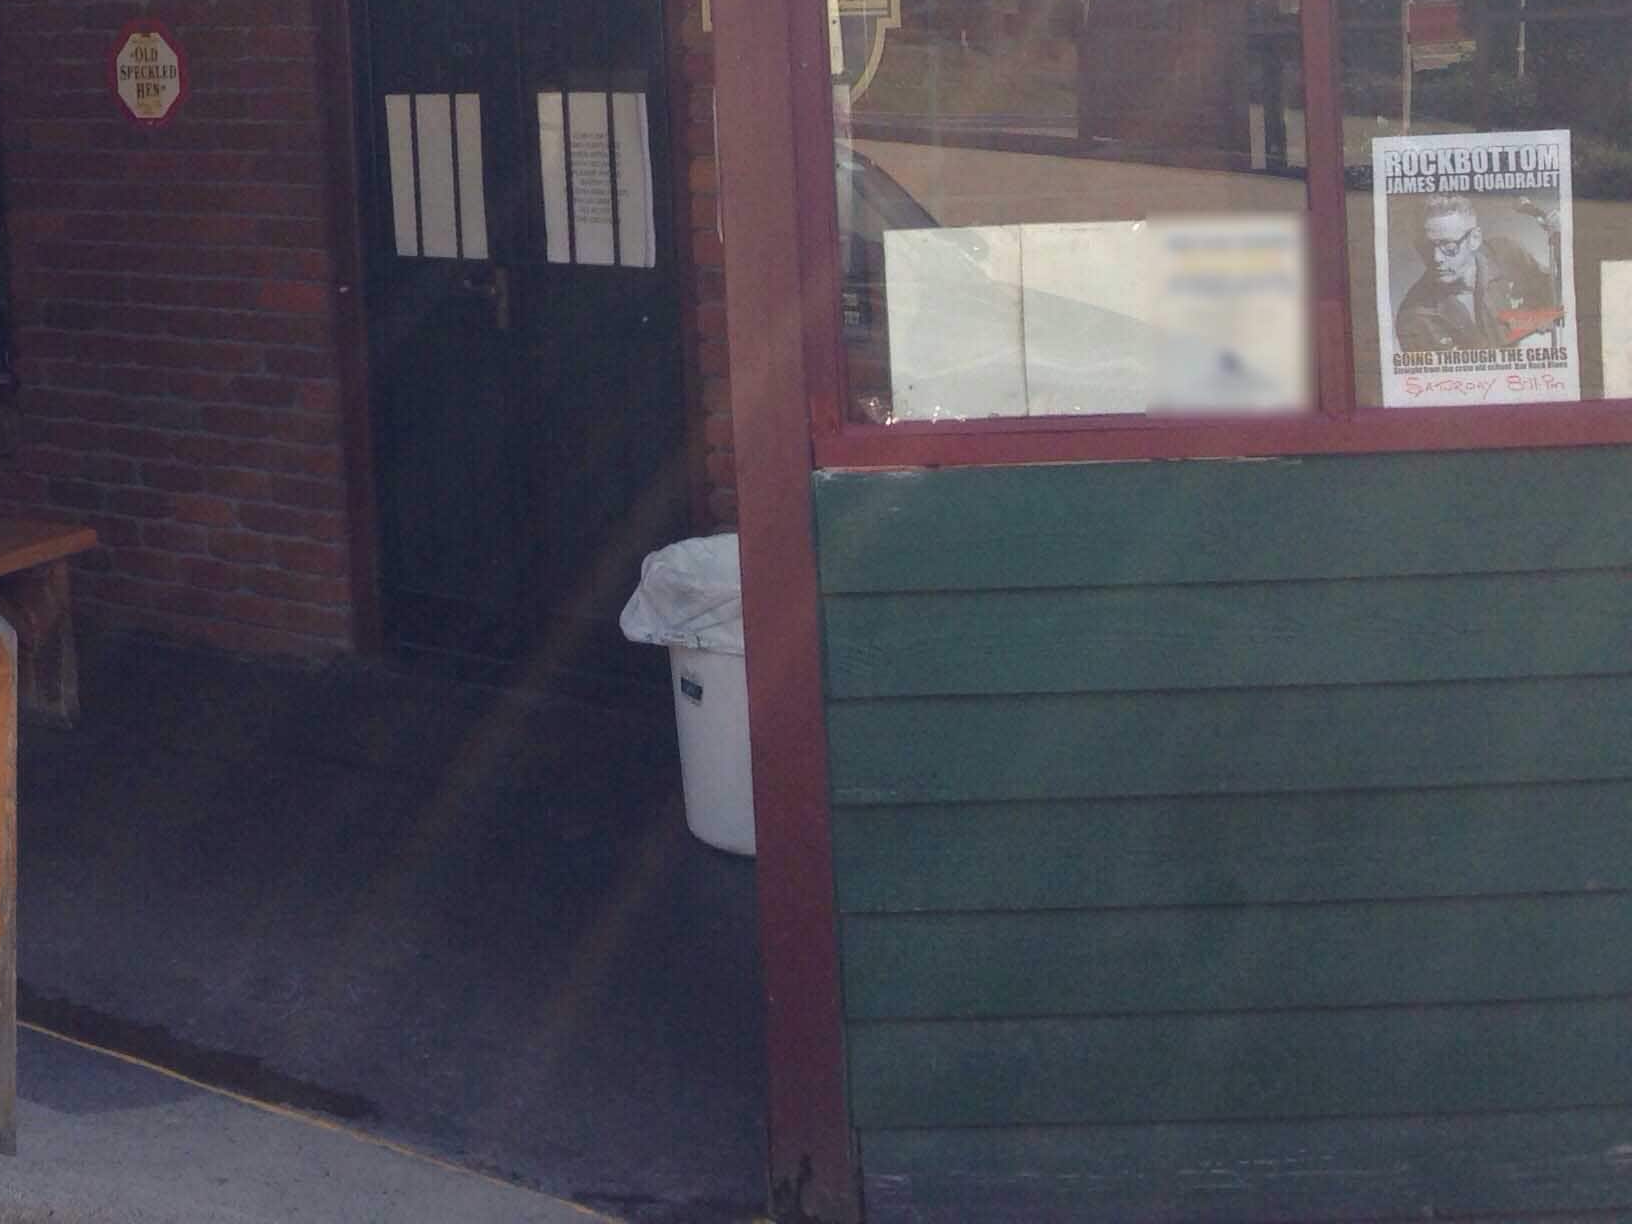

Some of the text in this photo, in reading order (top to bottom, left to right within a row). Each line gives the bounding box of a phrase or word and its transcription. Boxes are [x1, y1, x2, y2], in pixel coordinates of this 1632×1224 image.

[119, 64, 177, 80] SPECKLED
[1384, 144, 1560, 176] ROCKBOTTOM
[1385, 171, 1560, 194] JAMES AND QUADRAJET
[1393, 346, 1568, 366] GOING THROUGH THE GEARS
